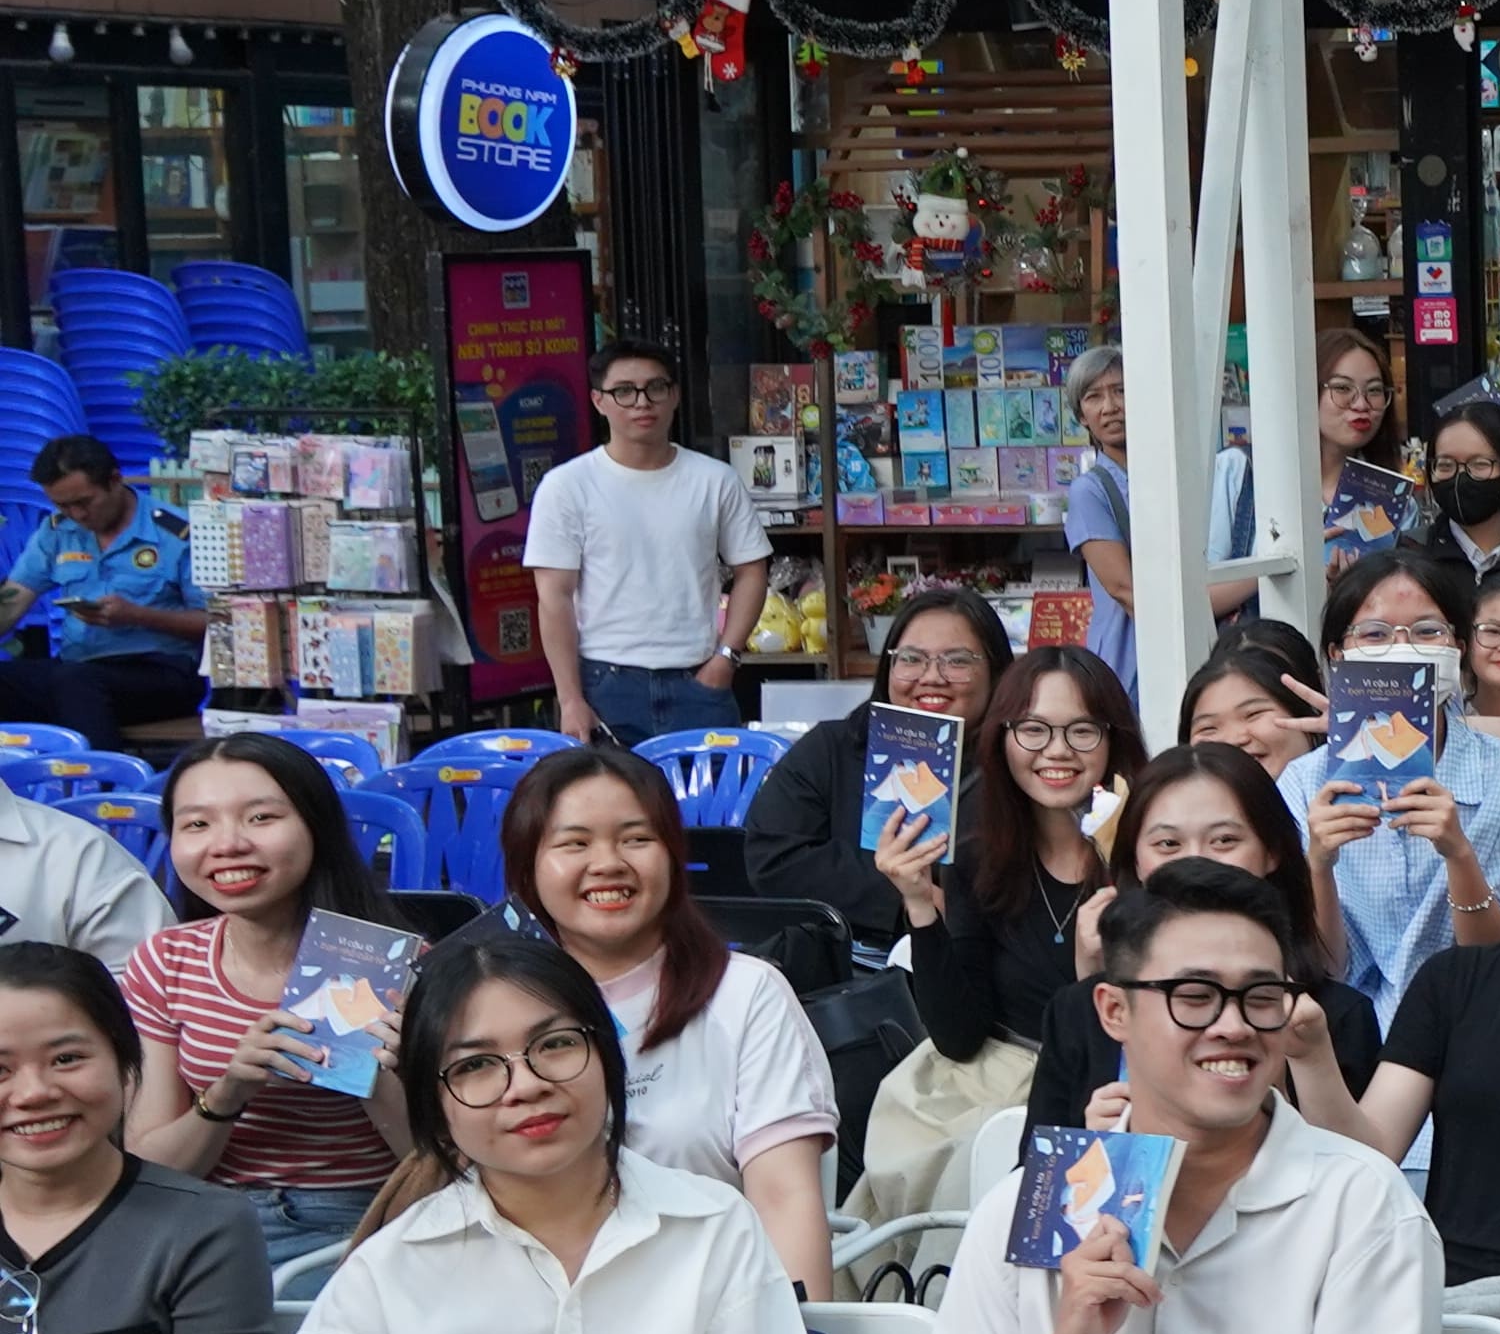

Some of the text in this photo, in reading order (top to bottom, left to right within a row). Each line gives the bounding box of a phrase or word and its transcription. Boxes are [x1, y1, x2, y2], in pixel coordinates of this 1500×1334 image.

[525, 88, 557, 105] NAM
[459, 93, 554, 147] BOOK
[456, 137, 552, 172] STORE
